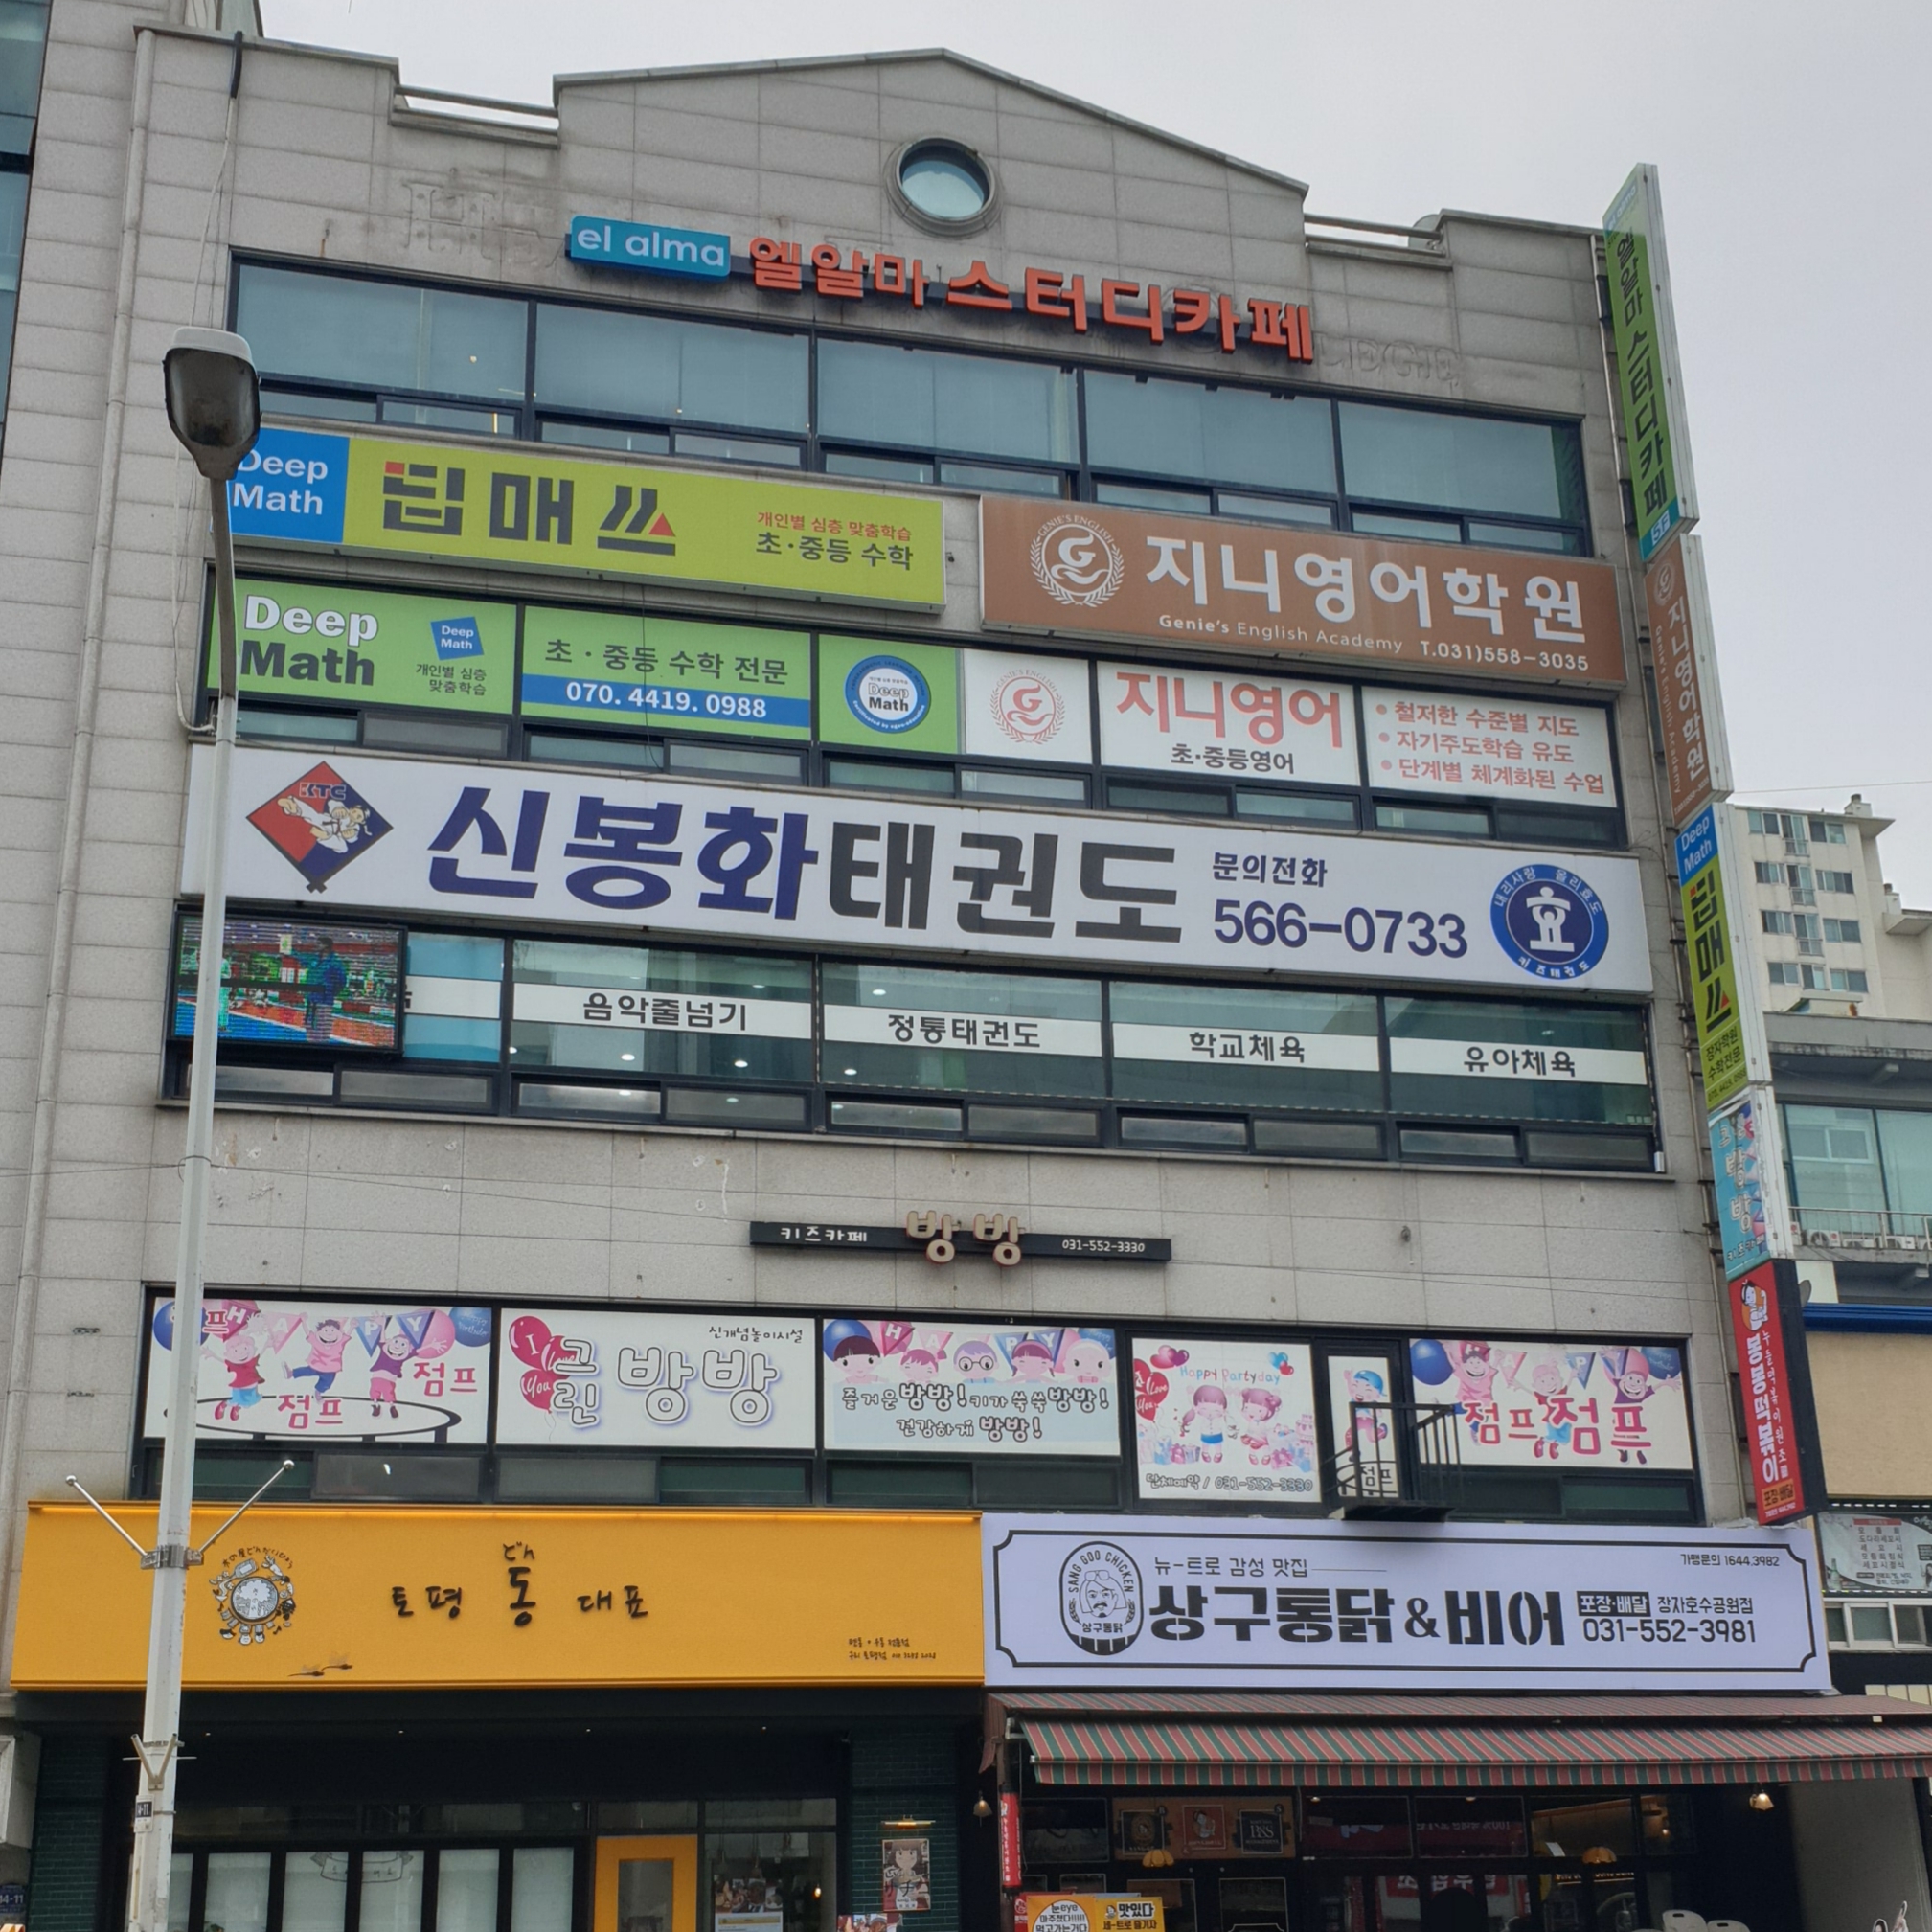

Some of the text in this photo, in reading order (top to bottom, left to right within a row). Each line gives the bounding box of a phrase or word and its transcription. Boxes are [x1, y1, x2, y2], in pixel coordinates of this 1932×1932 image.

[577, 225, 726, 269] el alma
[748, 236, 930, 310] 엘알마
[238, 448, 329, 485] Deep
[232, 483, 324, 516] Math
[757, 511, 912, 543] 개인별 심층 맞춤학습
[1074, 515, 1115, 544] ENGLISH
[1651, 510, 1670, 546] 5F
[861, 543, 914, 572] 수학
[1146, 534, 1586, 645] 지니영어학원
[243, 593, 379, 647] Deep
[441, 625, 475, 640] Deep
[1158, 612, 1231, 636] Genie's
[1237, 620, 1309, 647] English
[1315, 626, 1404, 655] Academy
[440, 637, 474, 651] Math
[239, 639, 375, 687] Math
[415, 662, 488, 682] 개인별 심층
[669, 650, 725, 680] 수학
[734, 655, 789, 686] 전문
[429, 678, 488, 697] 맞춤학습
[868, 682, 910, 701] Deep
[868, 696, 909, 712] Math
[705, 693, 767, 719] 0988
[1115, 670, 1343, 750] 지니영어
[1393, 700, 1580, 738] 철저한 수준별 지도
[1397, 729, 1575, 764] 자기주도학습 유도
[1398, 757, 1605, 797] 단계별 체계화된 수업
[1681, 814, 1710, 852] Deep
[1212, 851, 1329, 889] 문의전화
[1683, 839, 1713, 876] Math
[1213, 898, 1469, 959] 566-0733
[582, 991, 748, 1032] 음악줄넘기
[887, 1011, 1042, 1051] 정통태권도
[1189, 1030, 1307, 1064] 학교체육
[1463, 1045, 1577, 1078] 유아체육
[779, 1224, 868, 1244] 키즈카페
[905, 1210, 1027, 1266] 방방
[1061, 1239, 1147, 1254] 031-552-3330
[413, 1361, 478, 1398] 점프
[616, 1345, 779, 1424] 방방
[1179, 1365, 1218, 1383] Happy
[277, 1394, 343, 1430] 점프
[841, 1387, 898, 1411] 즐거운
[968, 1395, 1009, 1409] 키가
[895, 1418, 975, 1439] 건강하게
[1463, 1396, 1653, 1456] 점프 점프
[1105, 1551, 1135, 1593] CHICKEN
[1229, 1557, 1265, 1579] 감성
[1272, 1558, 1308, 1579] 맛집
[1680, 1553, 1721, 1567] 가맹문의
[1657, 1595, 1754, 1616] 장자호수공원점
[1081, 1622, 1124, 1634] 상구통닭
[1582, 1618, 1756, 1644] 031-552-3981
[1118, 1902, 1155, 1918] 맛있다
